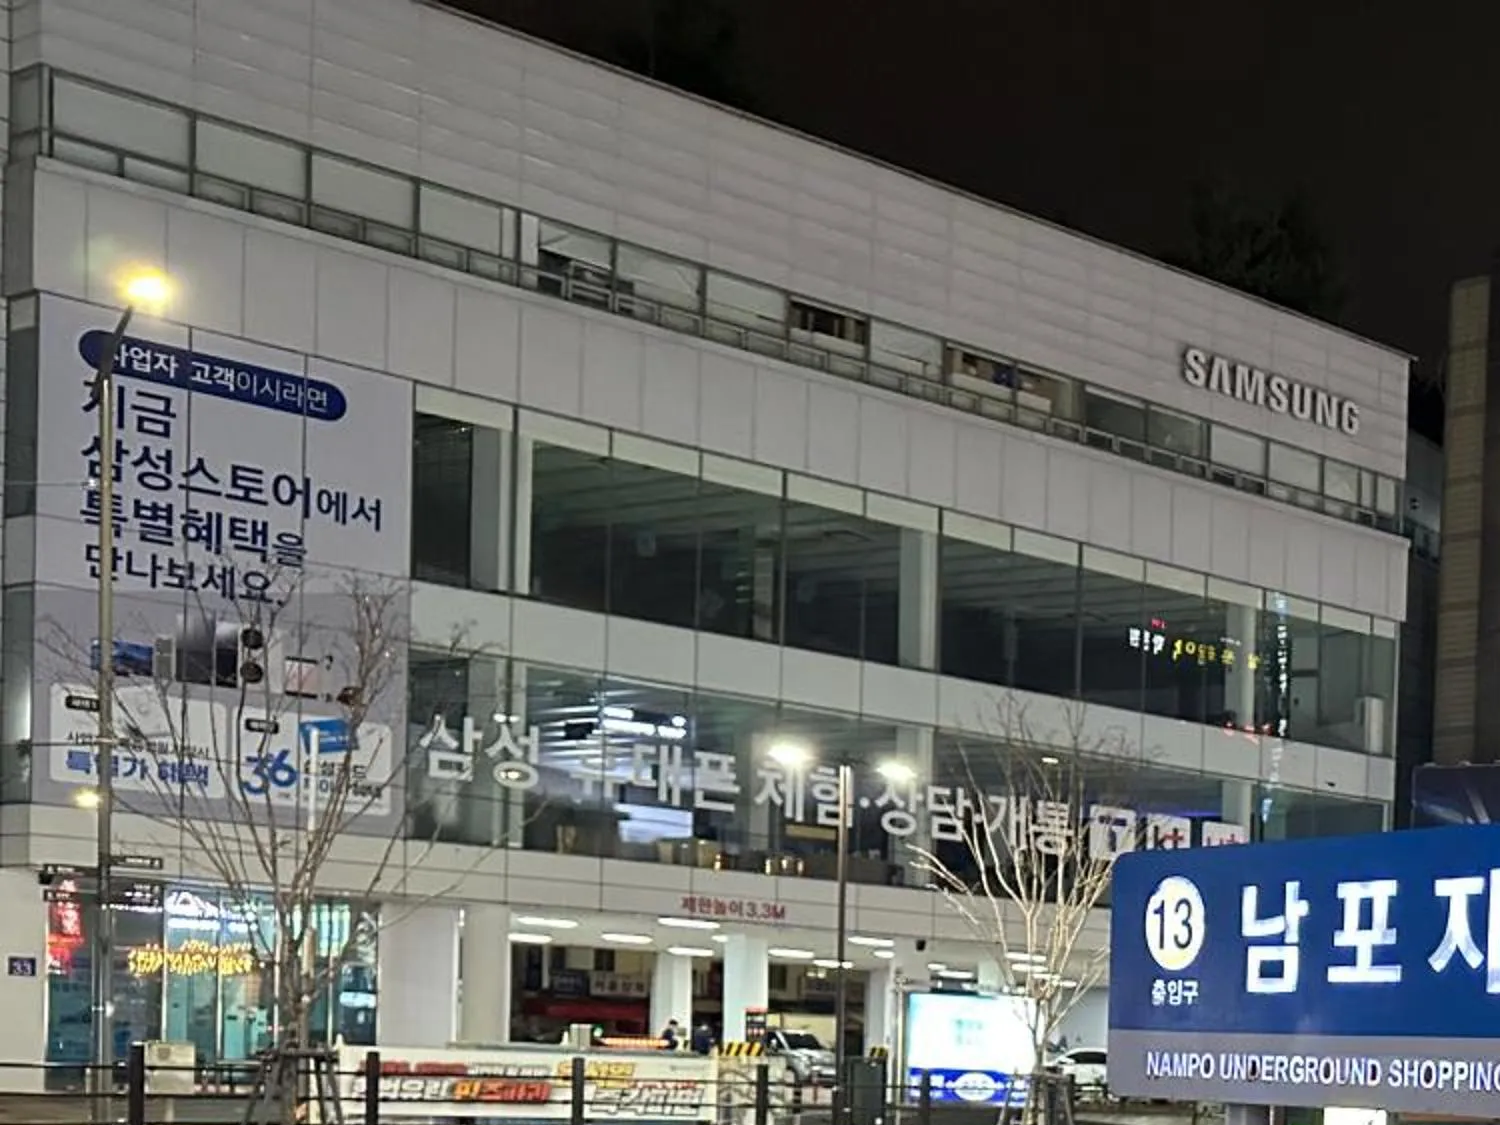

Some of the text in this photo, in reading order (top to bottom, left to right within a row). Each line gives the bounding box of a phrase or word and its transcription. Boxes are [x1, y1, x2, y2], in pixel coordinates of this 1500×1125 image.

[1184, 348, 1361, 435] SAMSUNG
[81, 436, 382, 532] 삼성스토어에서
[80, 489, 308, 568] 특별혜택을
[419, 713, 541, 791] 삼성
[568, 741, 741, 813] 휴대폰
[1151, 897, 1194, 951] 13
[1151, 979, 1199, 1007] 출입구
[1146, 1050, 1215, 1081] NAMPO
[1219, 1054, 1382, 1089] UNDERGROUND
